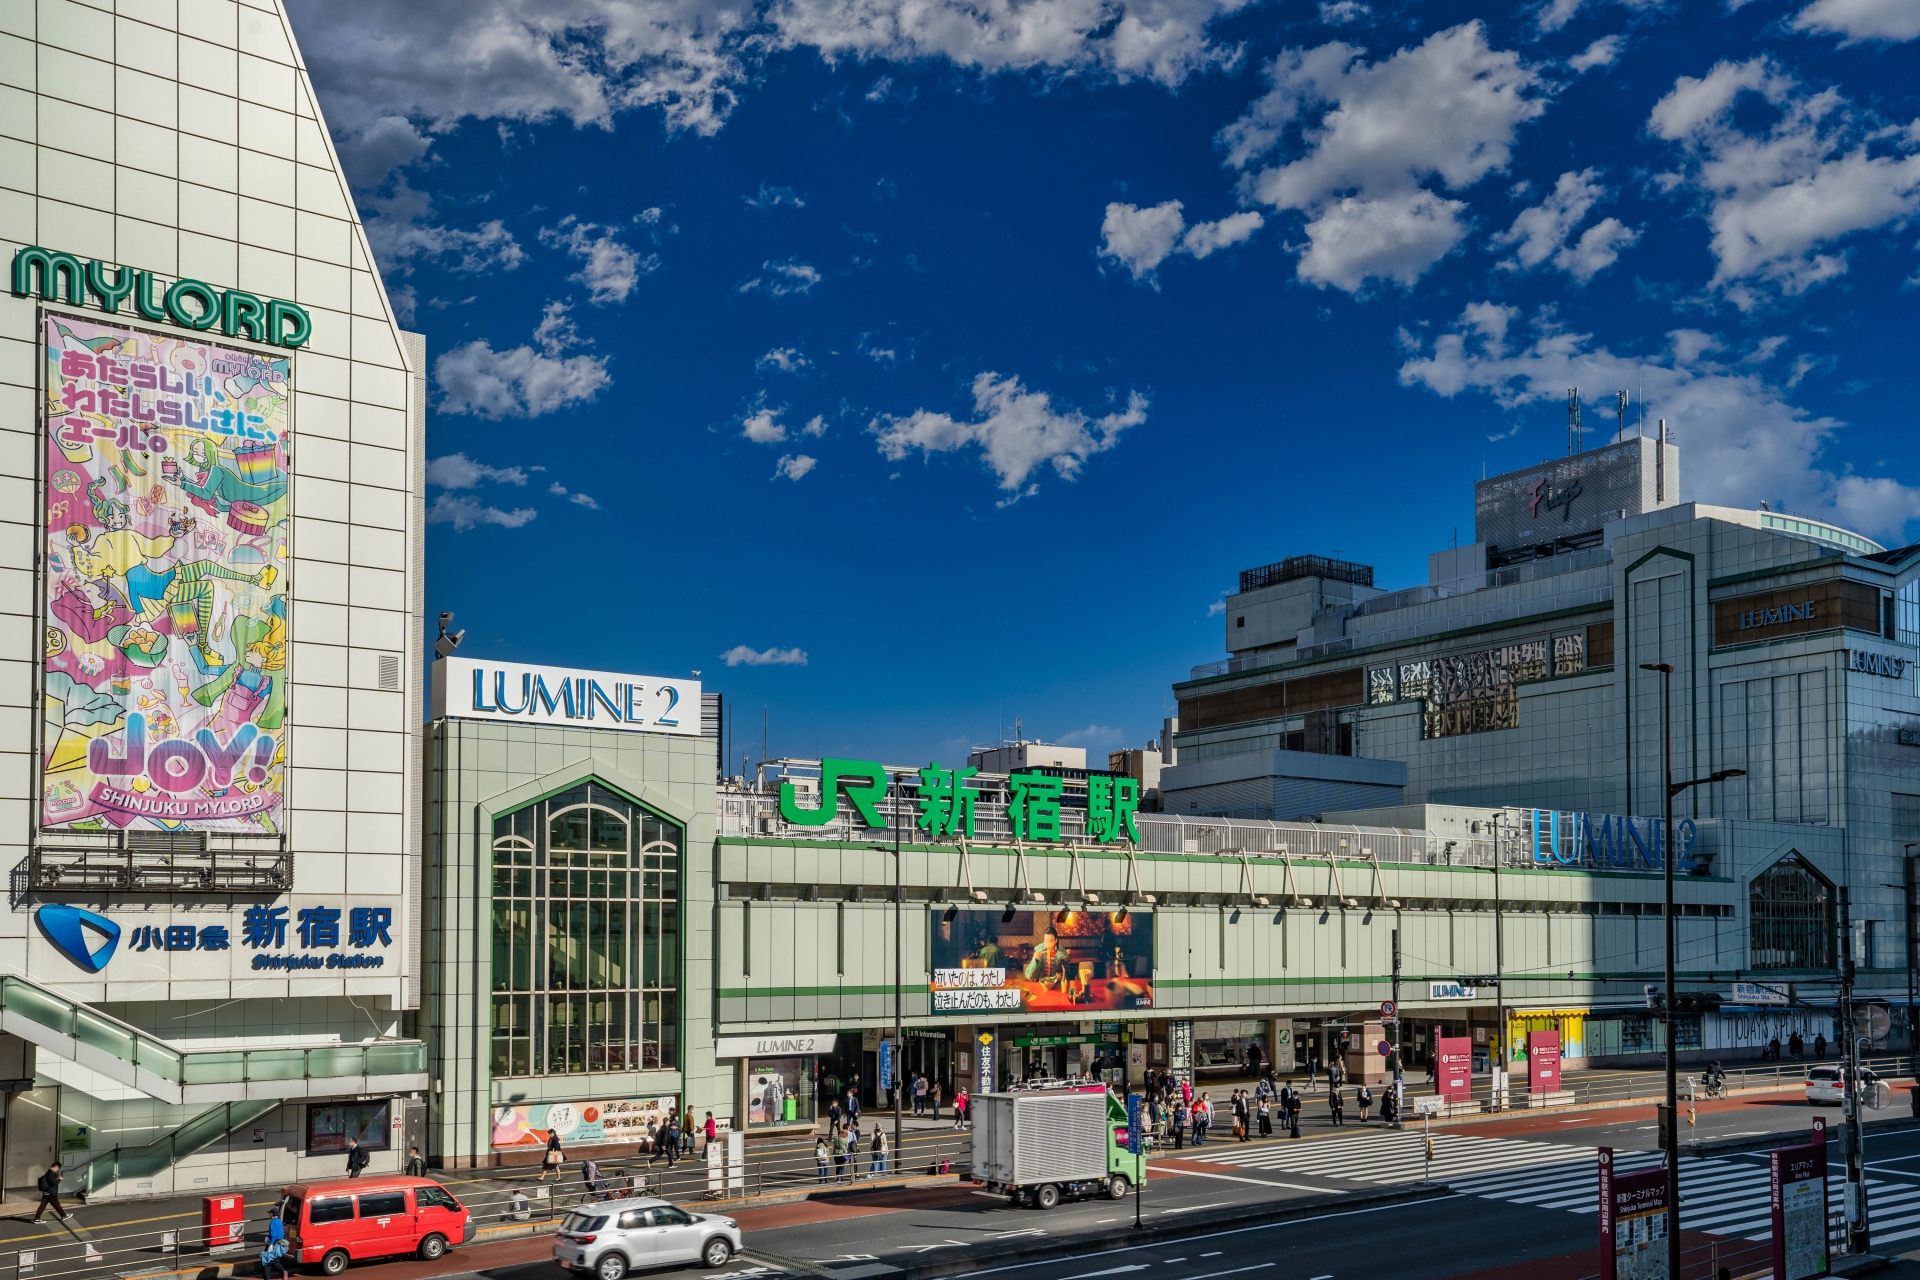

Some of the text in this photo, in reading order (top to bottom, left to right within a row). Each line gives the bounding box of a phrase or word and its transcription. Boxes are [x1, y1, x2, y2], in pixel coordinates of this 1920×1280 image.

[15, 246, 312, 348] MYLORD
[211, 358, 285, 383] MYLORD
[225, 354, 272, 367] shinjuku
[61, 349, 226, 402] あたらしい、
[61, 382, 278, 442] わたしらしさに、
[61, 417, 168, 453] エール。
[1741, 600, 1815, 630] LUMINE
[1850, 648, 1907, 679] LUMINE 2
[473, 668, 680, 726] LUMINE 2
[89, 712, 275, 793] JOY!
[100, 789, 264, 816] SHINJUKU MYLORD
[779, 757, 1141, 844] JR 新宿駅
[1533, 809, 1697, 868] LUMINE 2
[130, 904, 393, 950] 小田急 新宿駅
[254, 953, 384, 972] Shinjuku Station
[935, 969, 1006, 988] 泣いたのは、わたし。
[1433, 984, 1474, 998] LUMINE 2
[1736, 984, 1784, 995] 新宿駅南口
[935, 990, 1021, 1010] 泣き止んだのも、わたし。
[1411, 1008, 1445, 1018] LUMINE 2
[757, 1038, 815, 1054] LUMINE 2
[920, 1030, 946, 1039] Information
[981, 1046, 991, 1094] 住友不動産
[1790, 1159, 1814, 1172] エリアマップ
[1616, 1185, 1665, 1204] 新宿ターミナルマップ
[1771, 1152, 1780, 1210] 新宿駅南口周辺案内
[1601, 1168, 1609, 1234] 新宿駅南口周辺案内
[1619, 1198, 1662, 1214] Shinjuku Terminal Map
